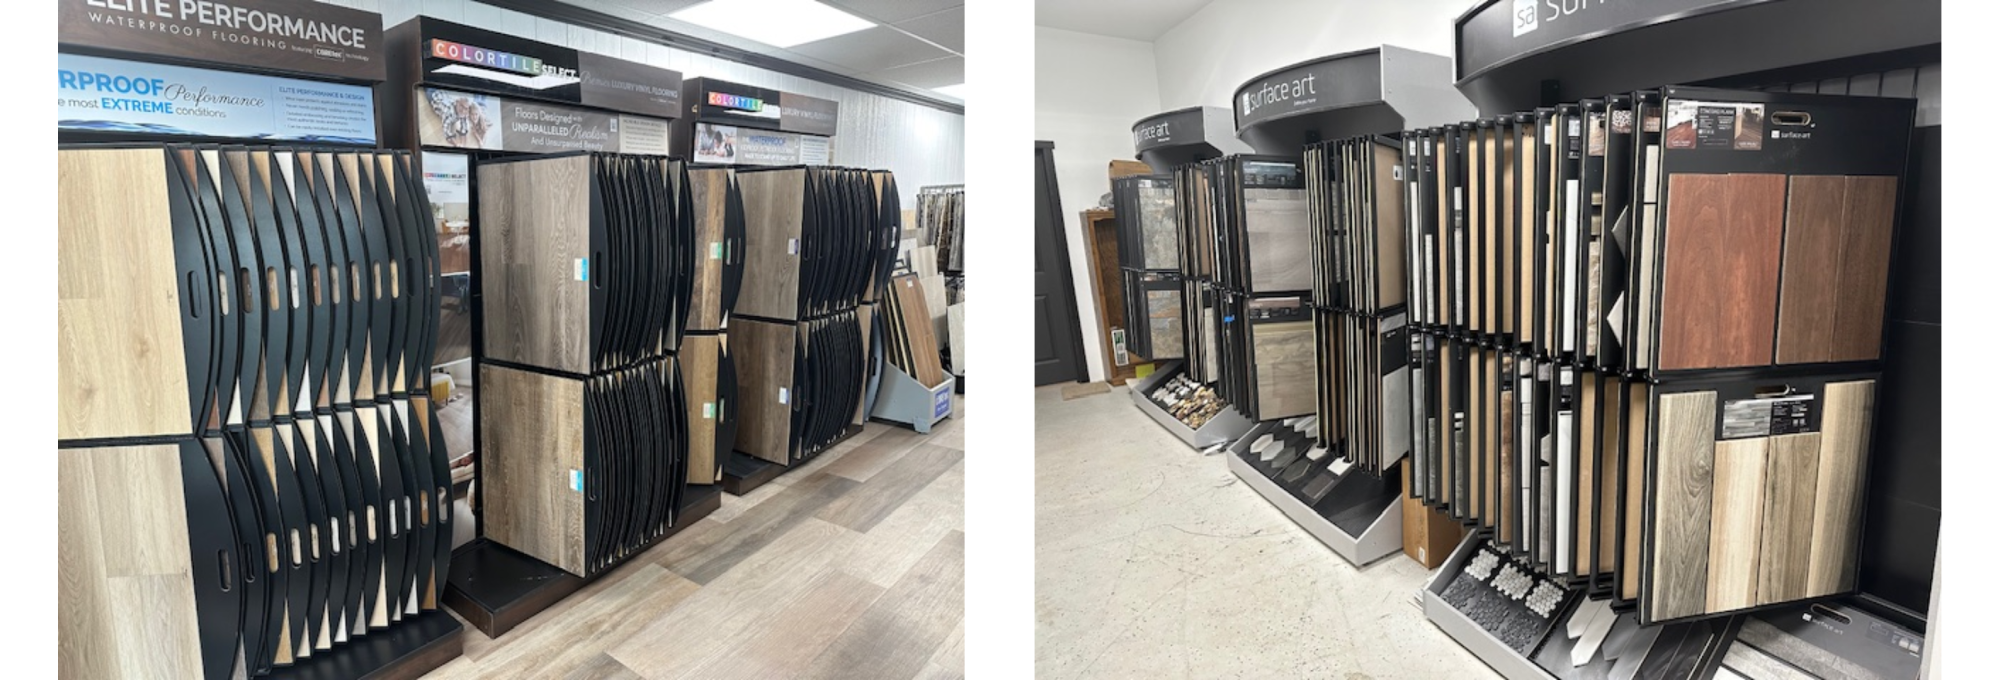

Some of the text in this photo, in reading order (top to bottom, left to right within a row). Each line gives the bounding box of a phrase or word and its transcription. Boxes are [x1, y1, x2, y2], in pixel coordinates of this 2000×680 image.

[180, 0, 366, 49] PERFORMANCE
[1517, 5, 1535, 29] sa
[88, 11, 202, 37] WATERPROOF
[212, 31, 287, 50] FLOORING
[435, 42, 576, 80] COLORTILE SELECT
[164, 83, 266, 107] Performance
[279, 86, 296, 95] ELITE
[297, 89, 339, 99] PERFORMANCE
[345, 93, 366, 101] DESIGN
[709, 92, 763, 112] COLORTILE
[1250, 82, 1289, 111] surface
[1292, 73, 1316, 98] art
[68, 99, 99, 109] most
[101, 97, 174, 114] EXTREME
[175, 107, 227, 119] conditions
[515, 106, 539, 120] Floors
[540, 110, 573, 125] Designed
[512, 121, 569, 136] UNPARALLELED
[1156, 120, 1170, 137] art
[531, 136, 544, 146] And
